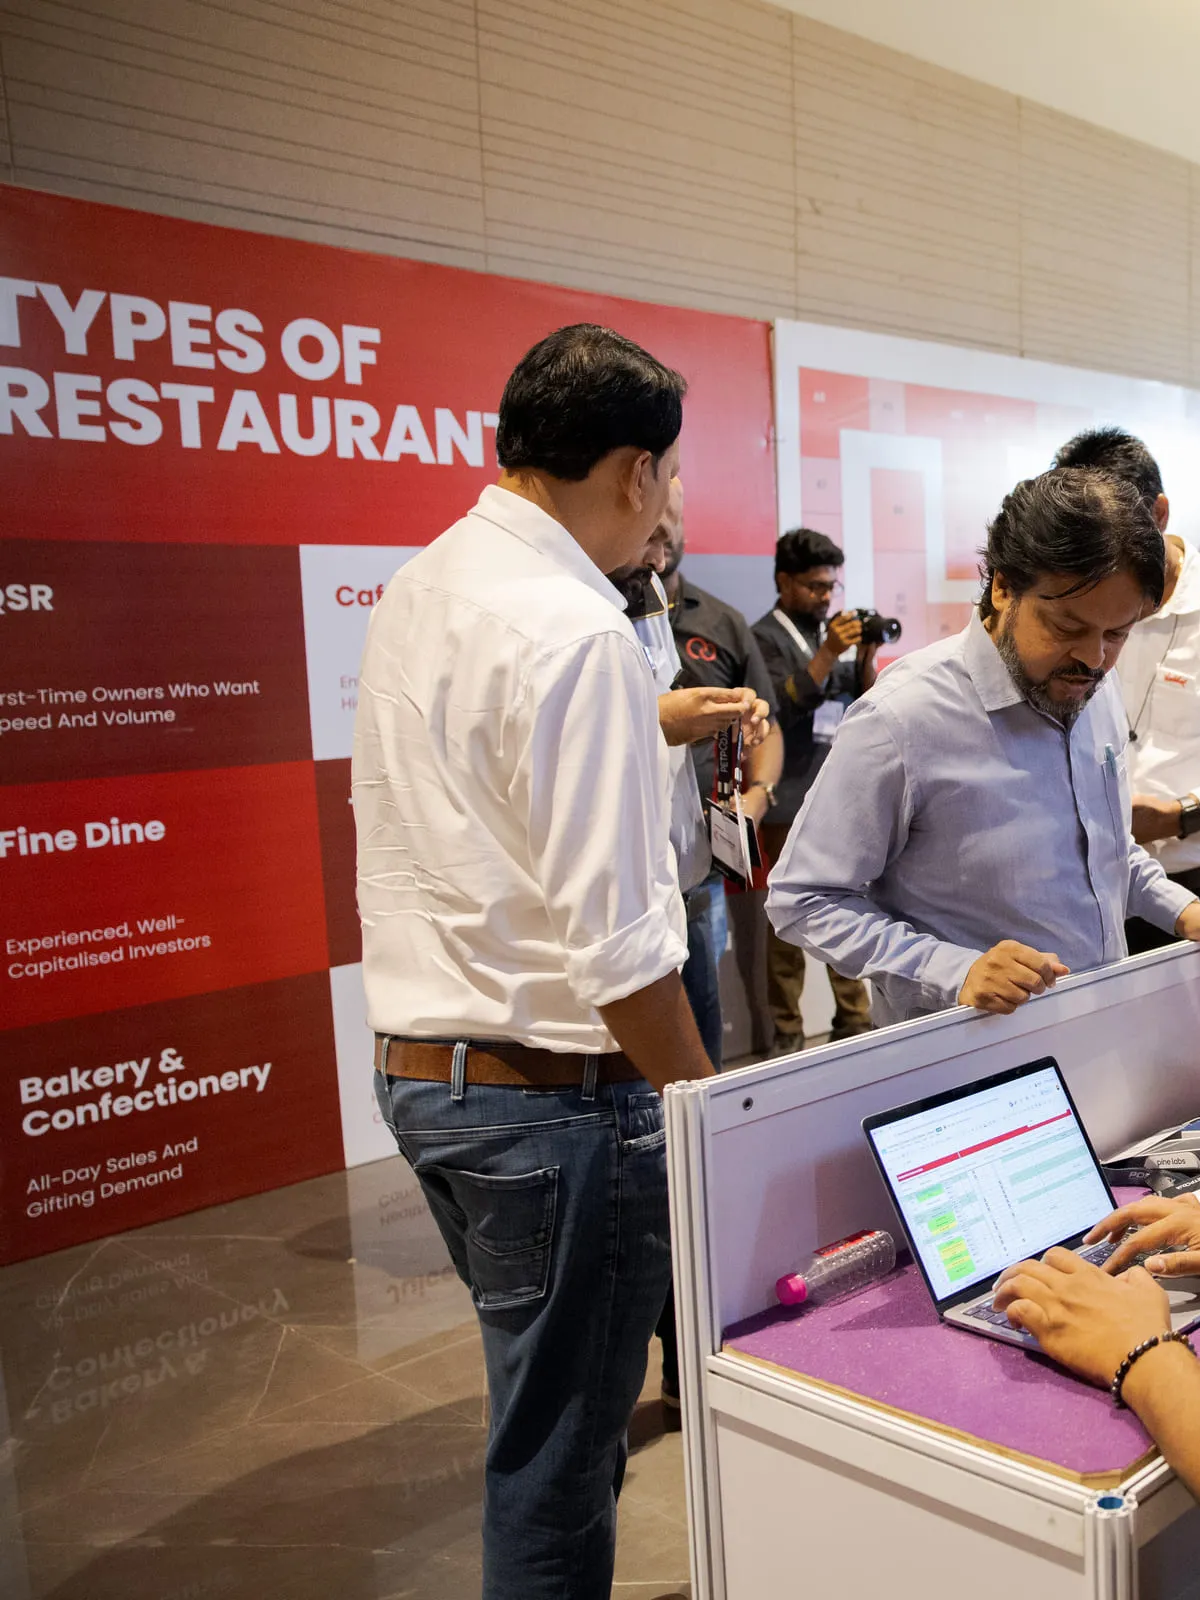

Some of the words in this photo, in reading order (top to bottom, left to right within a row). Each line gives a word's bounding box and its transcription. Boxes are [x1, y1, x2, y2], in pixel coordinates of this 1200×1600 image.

[0, 277, 267, 374] TYPES
[281, 318, 381, 385] OF
[335, 584, 384, 607] Caf
[92, 685, 164, 702] Owners
[169, 683, 209, 698] Who
[214, 680, 260, 695] Want
[58, 711, 97, 728] And
[102, 708, 176, 727] Volume
[0, 825, 78, 858] Fine
[85, 817, 166, 849] Dine
[6, 922, 133, 956] Experienced,
[136, 914, 185, 936] Well-
[7, 946, 124, 979] Capitalised
[129, 934, 211, 959] Investors
[19, 1057, 151, 1105] Bakery
[158, 1047, 185, 1074] &
[22, 1062, 272, 1137] Confectionery
[26, 1163, 101, 1195] All-Day
[106, 1149, 157, 1174] Sales
[162, 1137, 198, 1160] And
[1156, 1158, 1171, 1166] pine
[1171, 1157, 1186, 1165] labs
[26, 1187, 95, 1218] Gifting
[100, 1164, 183, 1199] Demand
